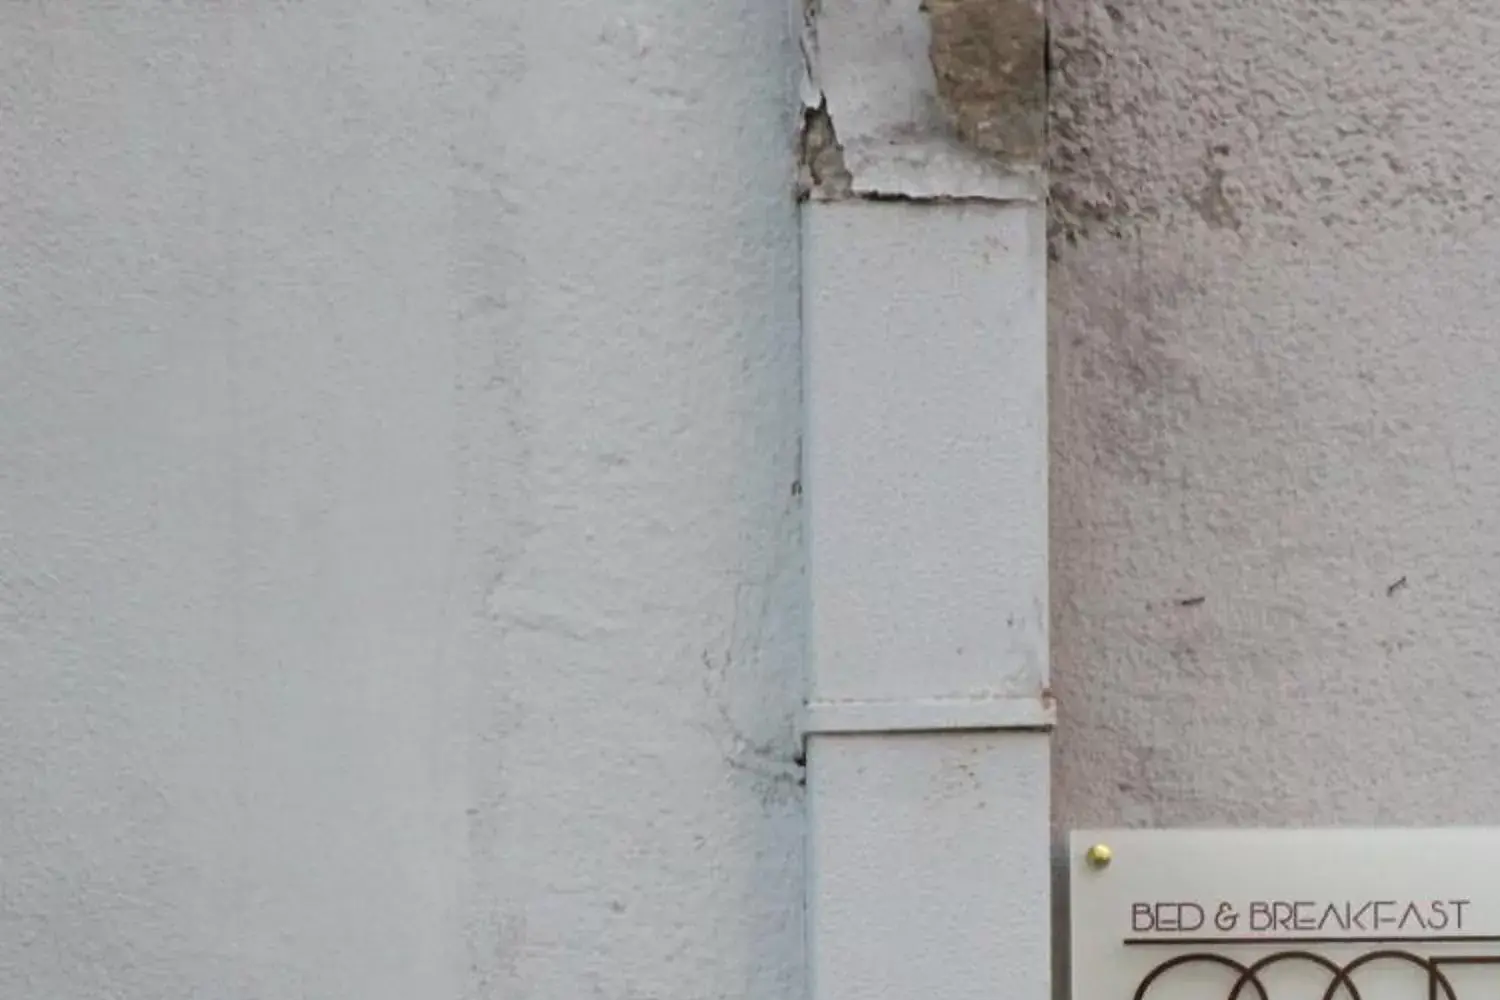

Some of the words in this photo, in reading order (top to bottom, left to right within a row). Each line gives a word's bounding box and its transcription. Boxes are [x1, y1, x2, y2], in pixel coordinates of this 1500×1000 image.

[1131, 902, 1205, 932] BED
[1213, 901, 1240, 932] &
[1250, 900, 1471, 931] BREAKFAST
